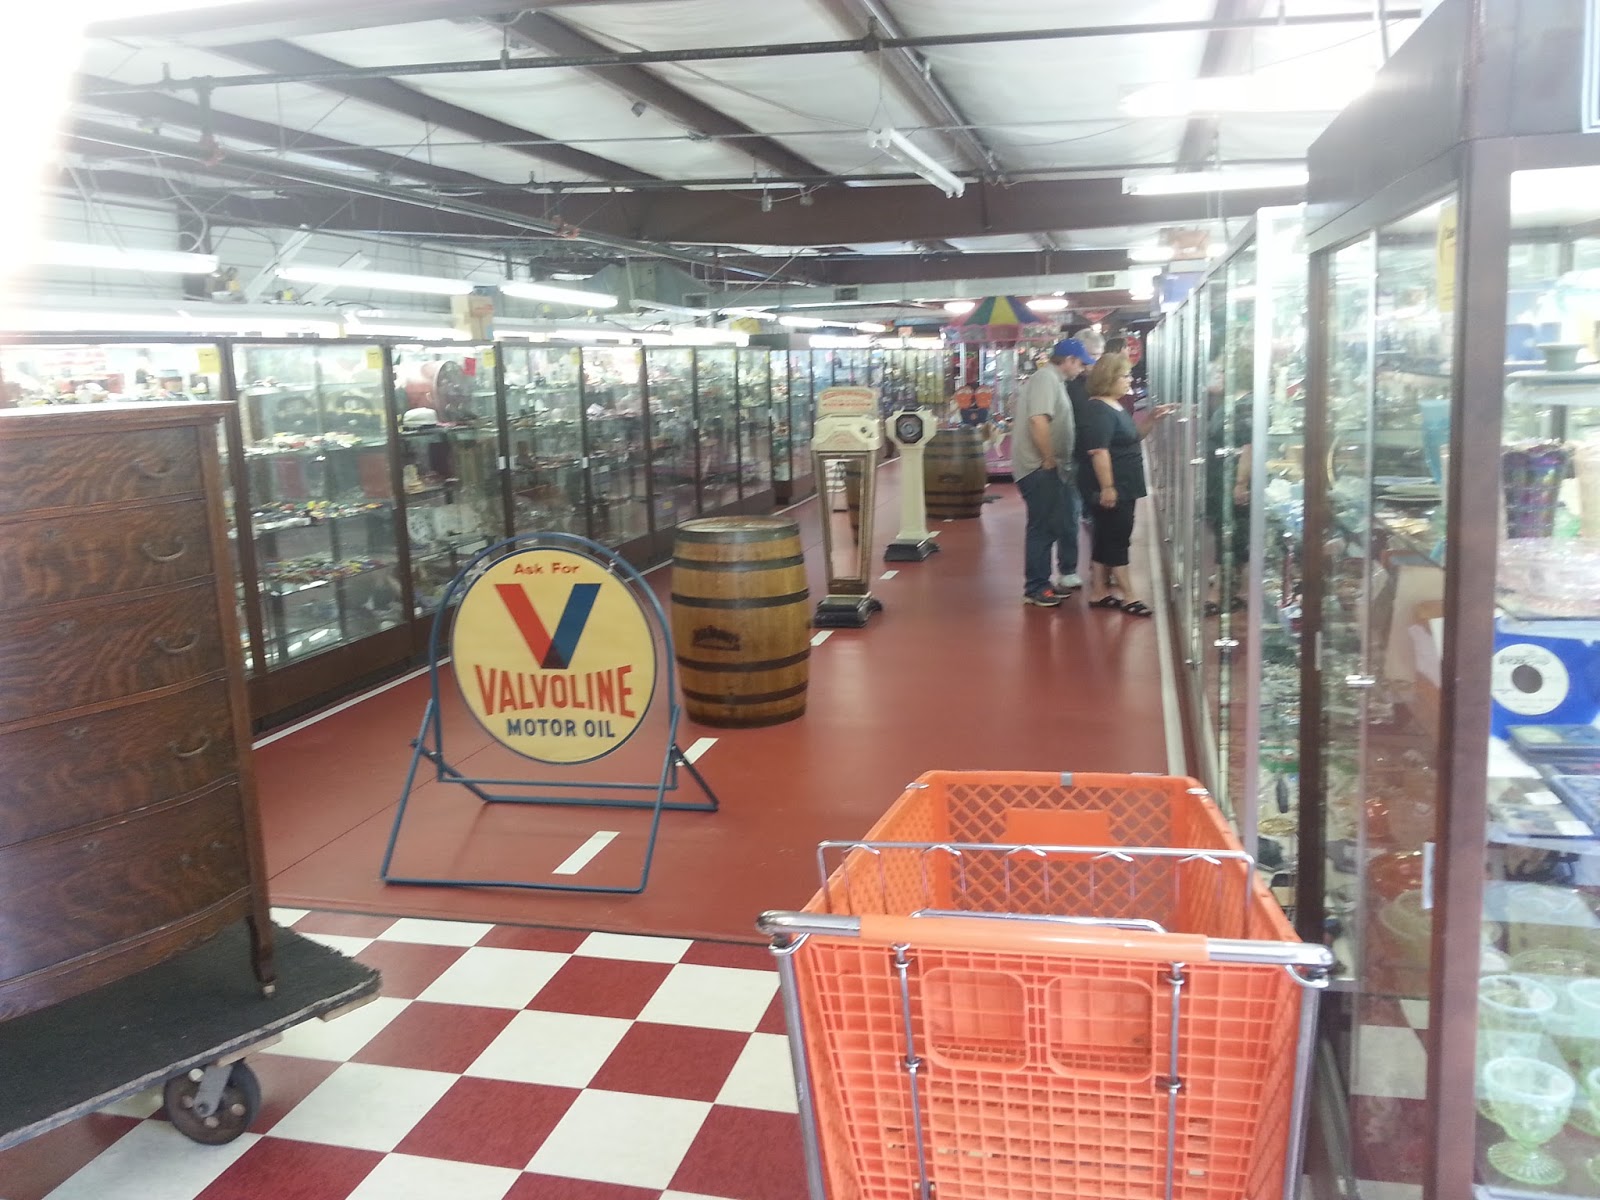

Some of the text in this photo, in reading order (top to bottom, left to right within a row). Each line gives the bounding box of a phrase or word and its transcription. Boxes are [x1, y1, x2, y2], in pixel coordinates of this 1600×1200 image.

[514, 562, 580, 575] Ask For
[495, 583, 602, 669] V
[474, 664, 636, 719] VALVOLINE
[507, 719, 616, 738] MOTOR OIL
